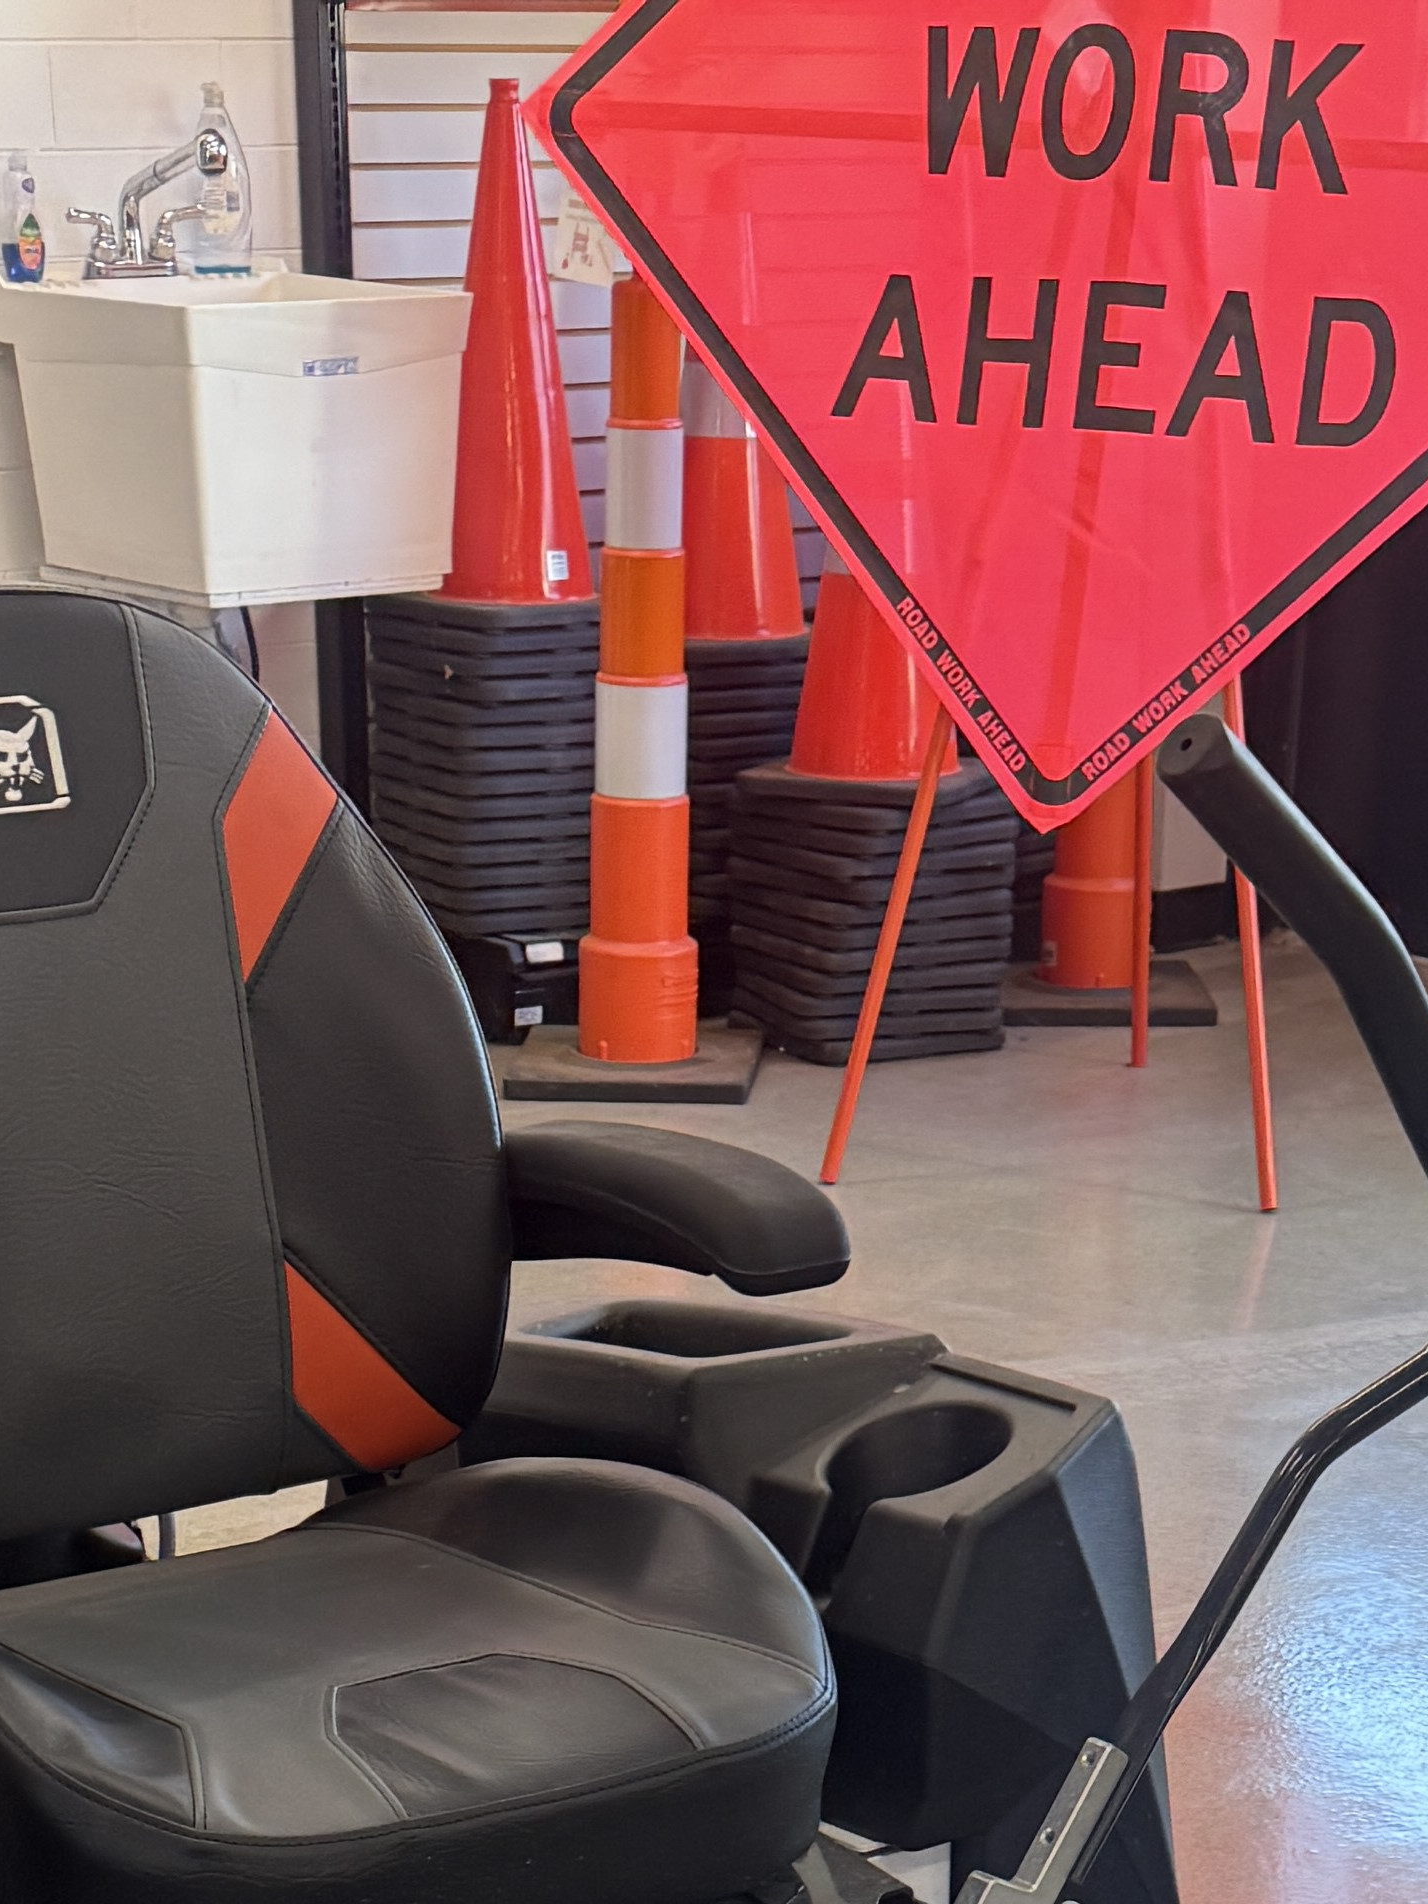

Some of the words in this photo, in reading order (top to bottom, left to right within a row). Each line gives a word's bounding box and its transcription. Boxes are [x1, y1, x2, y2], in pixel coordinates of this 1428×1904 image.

[928, 23, 1364, 195] WORK
[830, 274, 1396, 446] AHEAD
[896, 597, 938, 649] ROAD
[936, 649, 982, 709] WORK
[976, 710, 1026, 772] AHEAD
[1080, 732, 1131, 782] ROAD
[1132, 680, 1189, 734] WORK
[1190, 623, 1251, 684] AHEAD
